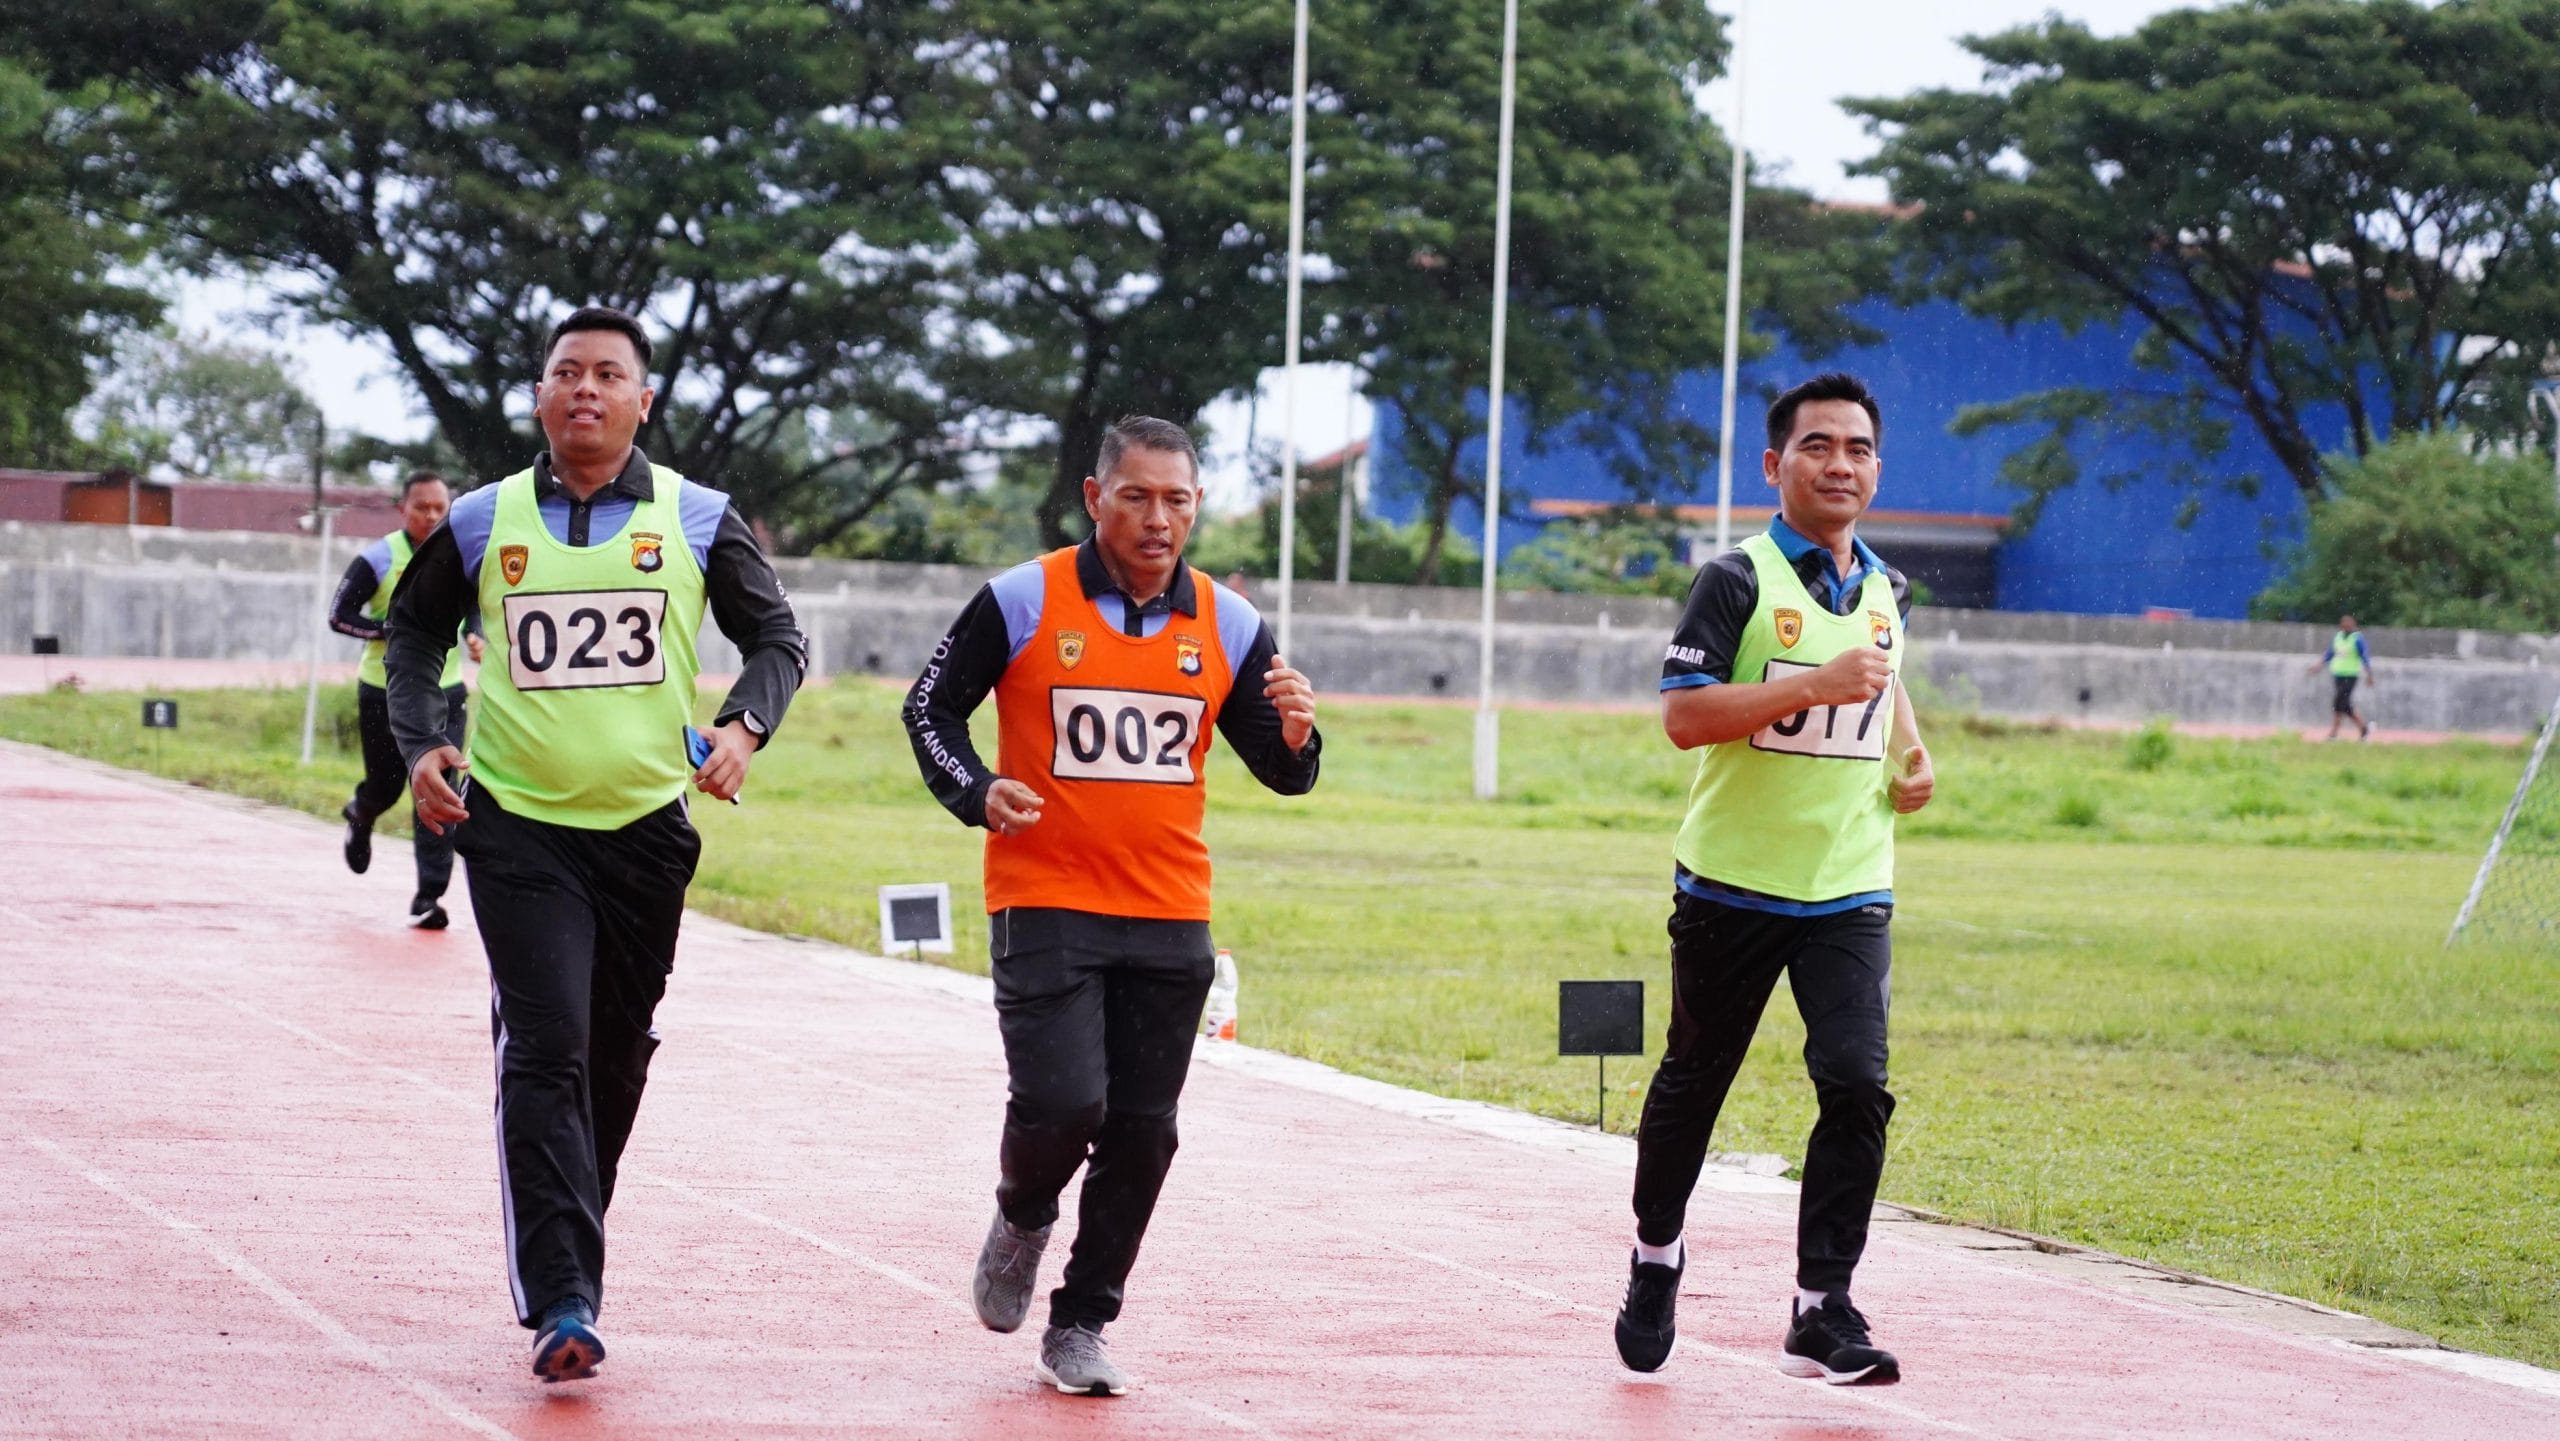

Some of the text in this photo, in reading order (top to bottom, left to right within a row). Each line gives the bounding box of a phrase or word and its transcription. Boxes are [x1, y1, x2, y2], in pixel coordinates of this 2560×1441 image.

[517, 607, 655, 672] 023
[933, 635, 955, 660] TO
[914, 664, 941, 728] PROT
[921, 730, 949, 767] AND
[1067, 704, 1188, 767] 002
